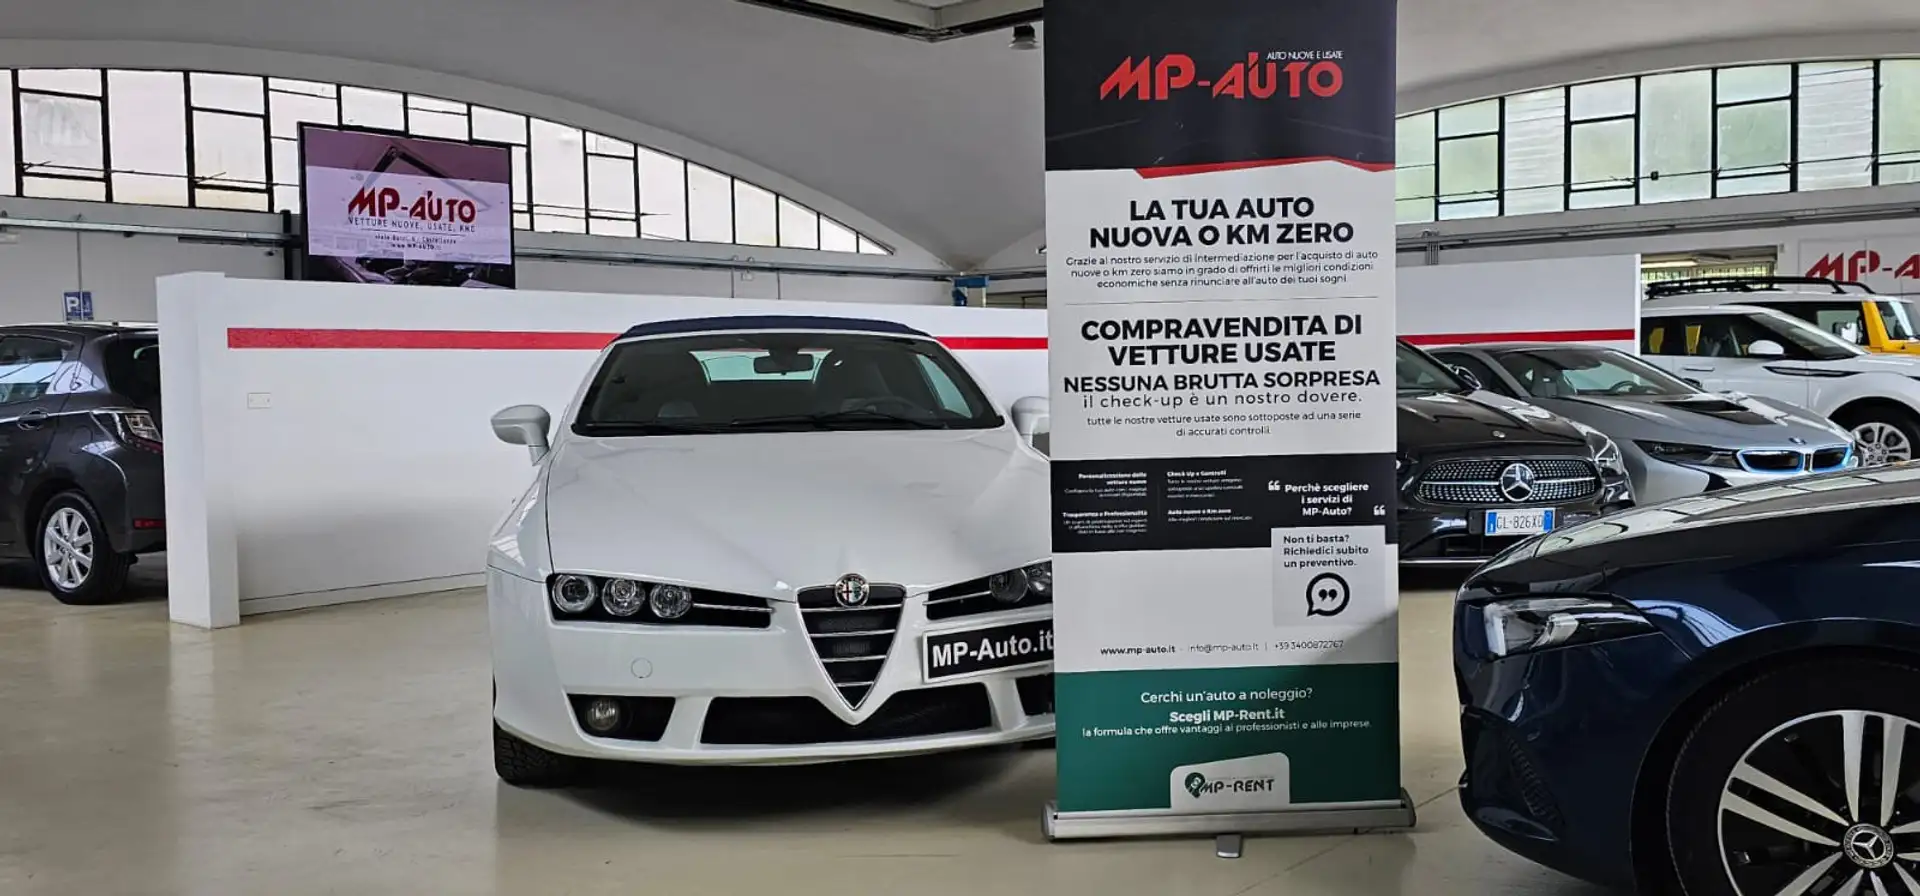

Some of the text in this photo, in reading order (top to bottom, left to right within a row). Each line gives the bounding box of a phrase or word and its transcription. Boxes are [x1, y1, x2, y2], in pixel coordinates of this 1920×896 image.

[1267, 51, 1344, 60] AUTO NUOVE E USATE
[1130, 197, 1314, 221] LA TUA AUTO
[349, 217, 388, 227] VETTURE
[1090, 226, 1192, 248] NUOVA
[1227, 224, 1269, 245] KM
[1277, 222, 1354, 243] ZERO
[1066, 256, 1097, 265] Grazie
[1099, 256, 1107, 265] al
[1111, 256, 1141, 265] nostro
[1144, 255, 1180, 264] servizio
[1183, 255, 1192, 263] di
[1278, 254, 1293, 263] per
[1345, 251, 1354, 260] di
[1112, 267, 1128, 276] km
[1154, 267, 1183, 276] siamo
[1186, 267, 1195, 275] in
[1197, 266, 1226, 276] grado
[1228, 264, 1238, 273] di
[1240, 264, 1270, 273] offrirti
[1272, 264, 1281, 272] le
[1283, 262, 1321, 273] migliori
[1324, 262, 1373, 272] condizioni
[1097, 279, 1158, 288] economiche
[1190, 278, 1240, 287] rinunciare
[1242, 276, 1278, 285] all'auto
[1281, 276, 1296, 284] dei
[1299, 275, 1318, 284] tuoi
[66, 297, 80, 313] P
[1081, 315, 1362, 341] COMPRAVENDITA DI
[1108, 341, 1336, 366] VETTURE USATE
[1064, 370, 1381, 393] NESSUNA BRUTTA SORPRESA
[1083, 390, 1362, 409] il check-up è un nostro dovere.
[1087, 411, 1361, 426] tutte le nostre vetture usate sono sottoposte ad una serie
[1176, 428, 1186, 437] di
[1188, 428, 1228, 436] accurati
[1323, 482, 1369, 493] scegliere
[1307, 495, 1340, 504] servizi
[1342, 495, 1353, 503] di
[1303, 507, 1352, 516] MP-Auto?
[1284, 534, 1350, 544] Non ti basta?
[1284, 545, 1369, 556] Richiedici subito
[1300, 558, 1358, 569] preventivo.
[933, 630, 1053, 668] MP-Auto.it
[1101, 645, 1175, 656] www.mp-auto.it
[1141, 688, 1313, 703] Cerchi un'auto a noleggio?
[1170, 708, 1286, 724] Scegli MP-Rent.it
[1083, 729, 1091, 737] la
[1094, 727, 1133, 736] formula
[1135, 726, 1152, 735] che
[1155, 725, 1178, 735] offre
[1180, 724, 1222, 734] vantaggi
[1225, 724, 1234, 732] ai
[1236, 722, 1300, 734] professionisti
[1311, 721, 1327, 729] alle
[1201, 779, 1274, 793] MP-RENT
